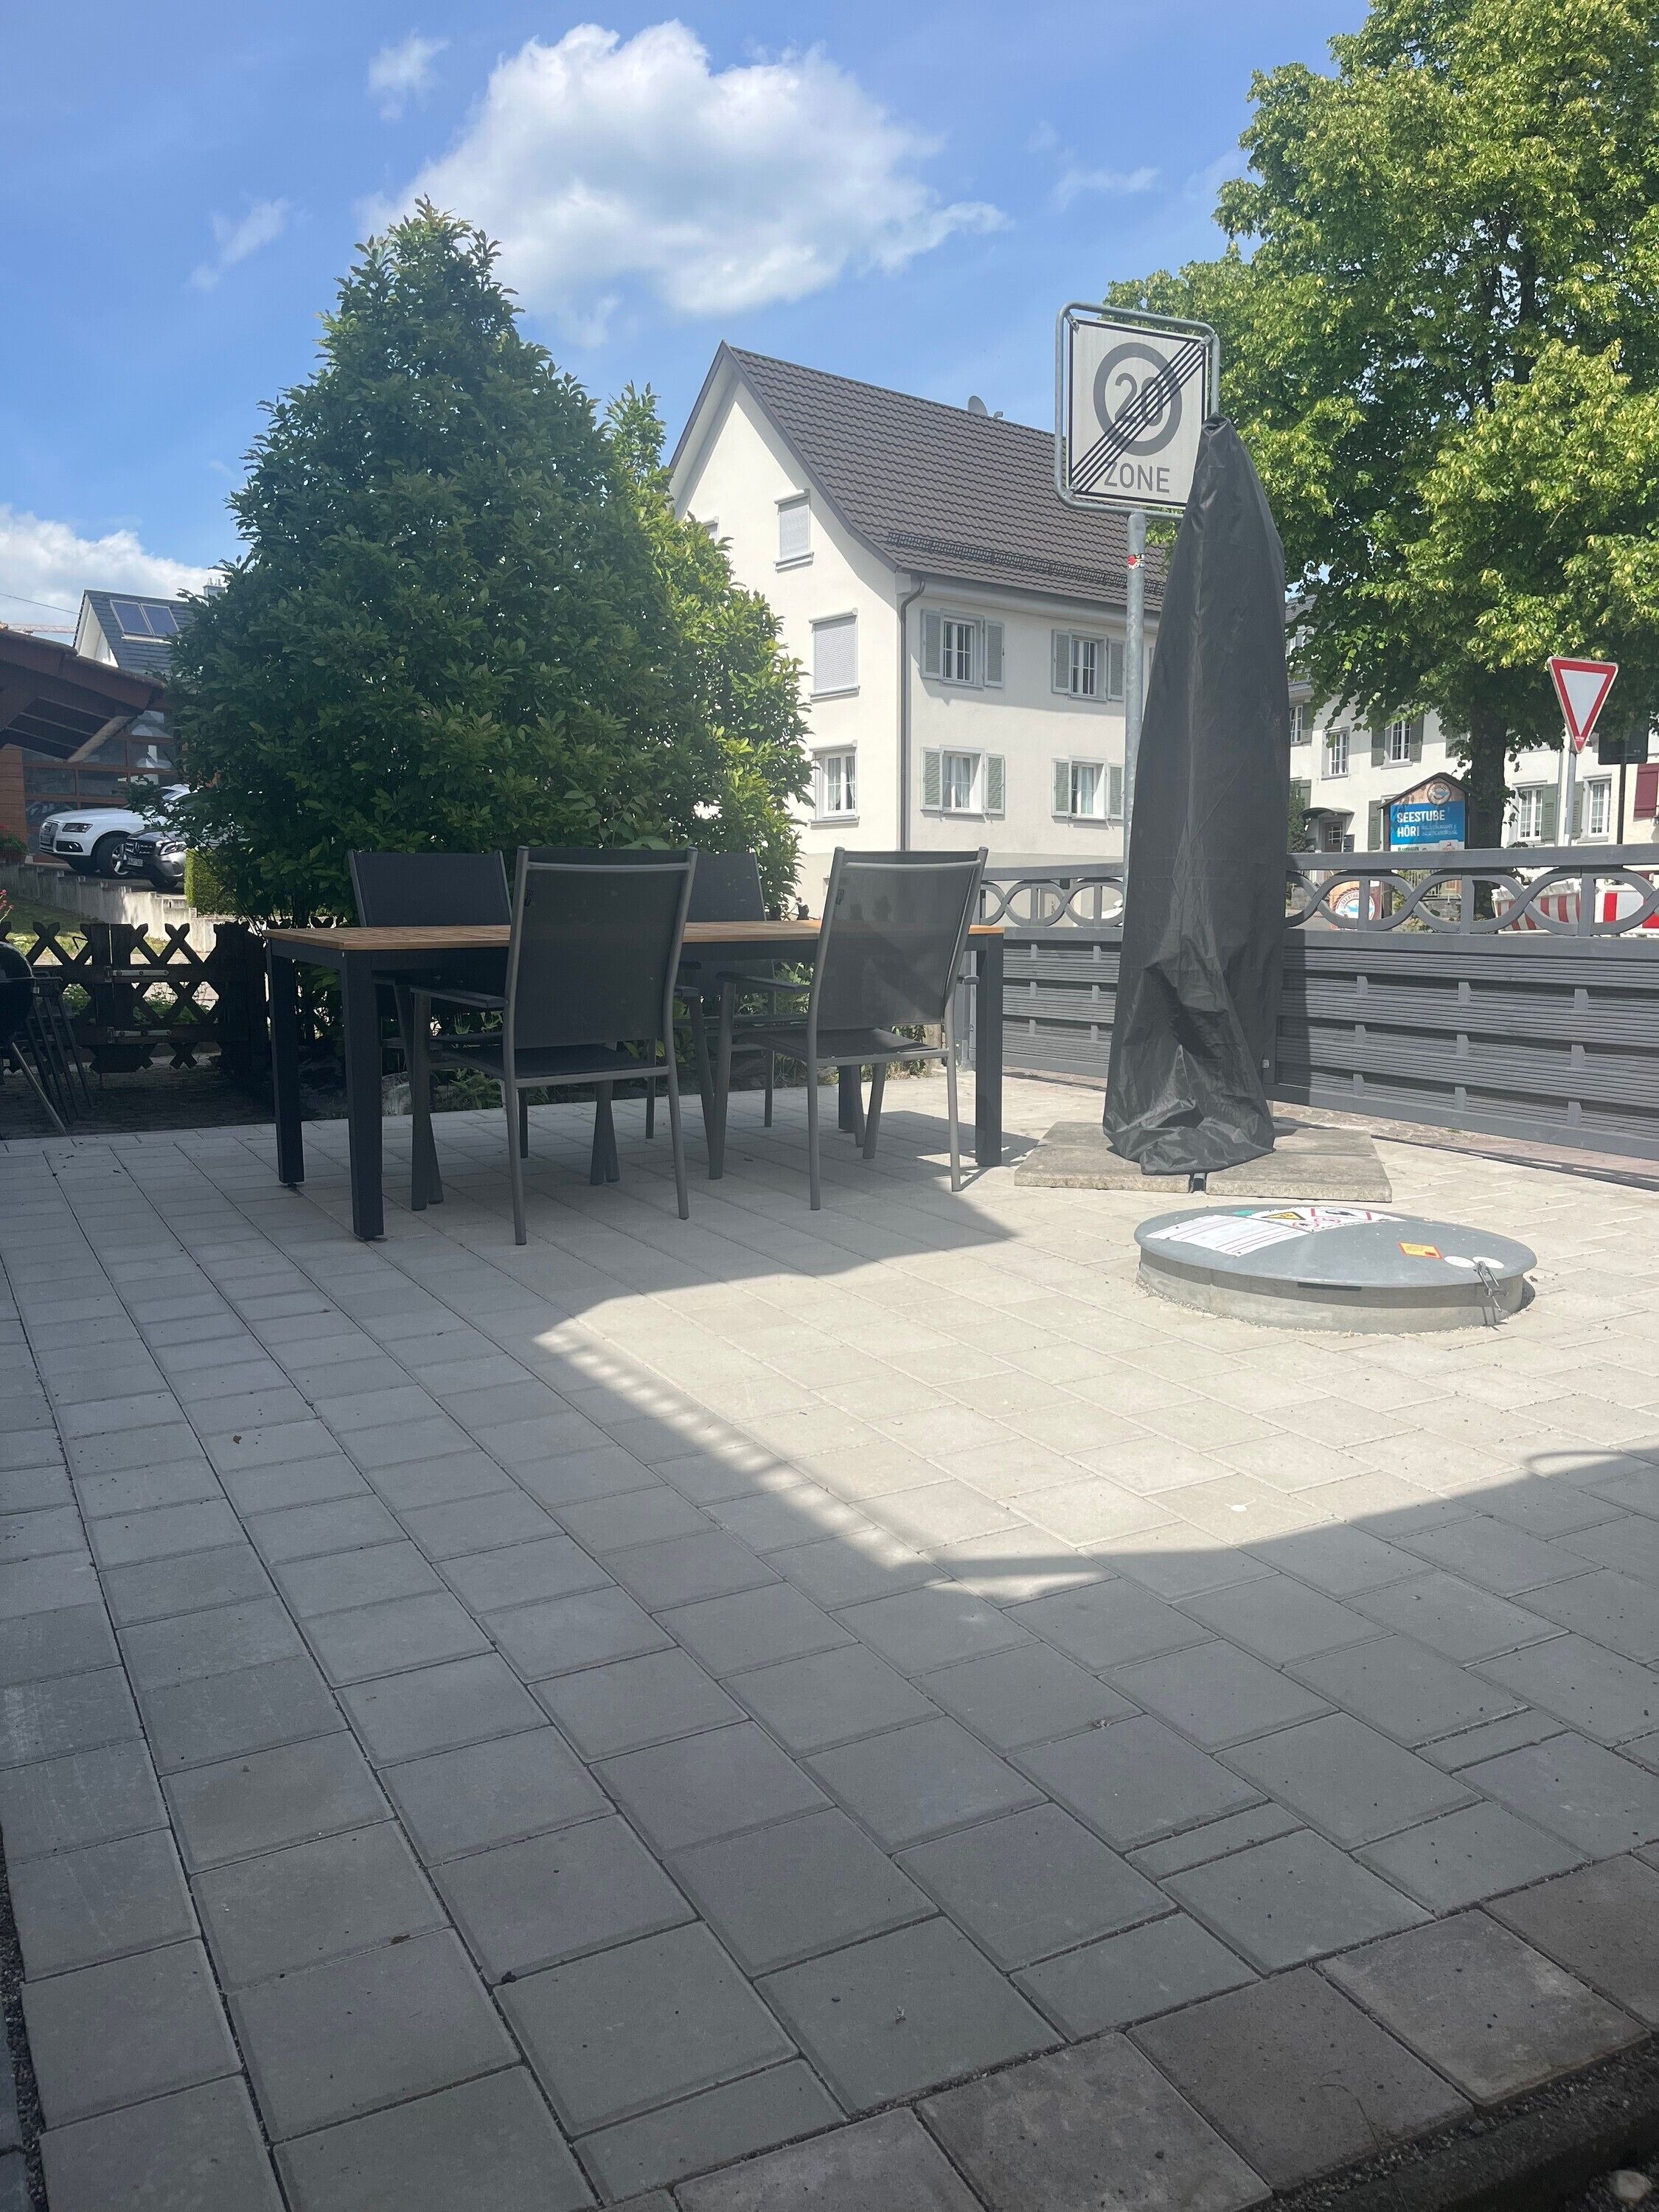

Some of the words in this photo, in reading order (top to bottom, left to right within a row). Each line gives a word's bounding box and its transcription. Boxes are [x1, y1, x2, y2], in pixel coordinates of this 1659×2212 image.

[1115, 372, 1164, 426] 20
[1104, 461, 1170, 493] ZONE
[1397, 810, 1445, 823] SEESTUBE
[1397, 824, 1420, 838] HÖRI
